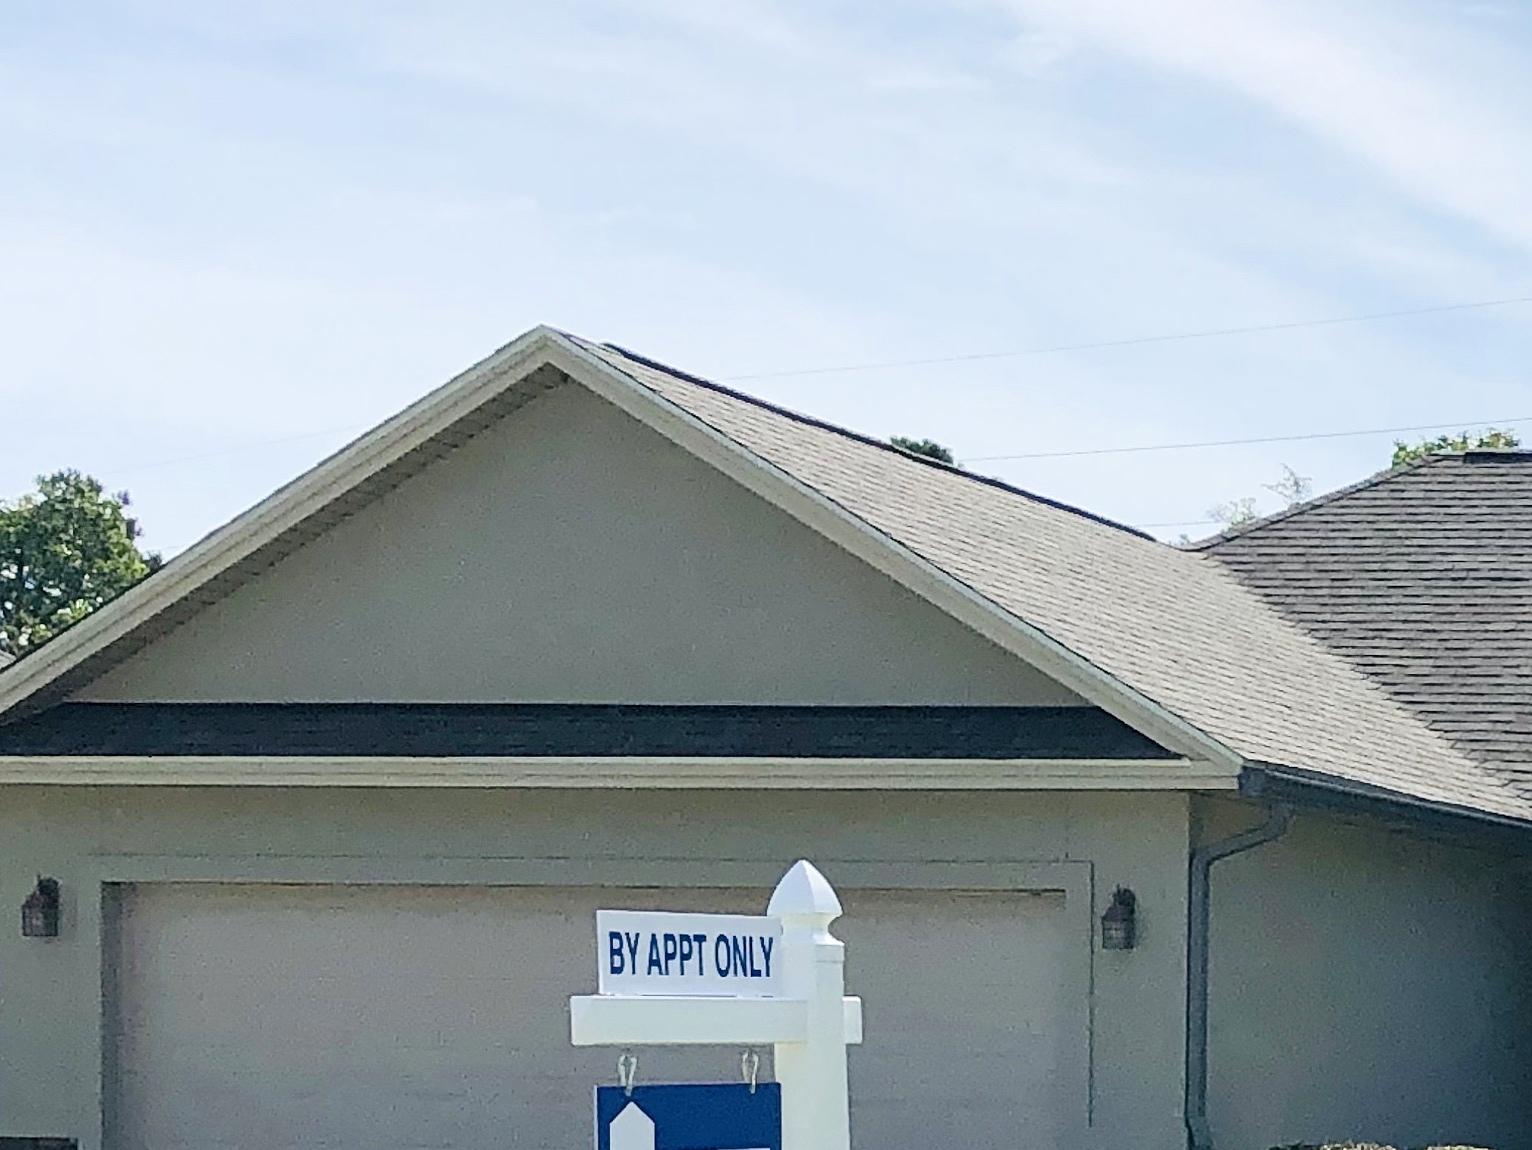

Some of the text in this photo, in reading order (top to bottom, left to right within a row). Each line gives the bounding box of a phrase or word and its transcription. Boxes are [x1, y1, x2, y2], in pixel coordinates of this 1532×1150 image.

[609, 931, 773, 978] BY APPT ONLY
